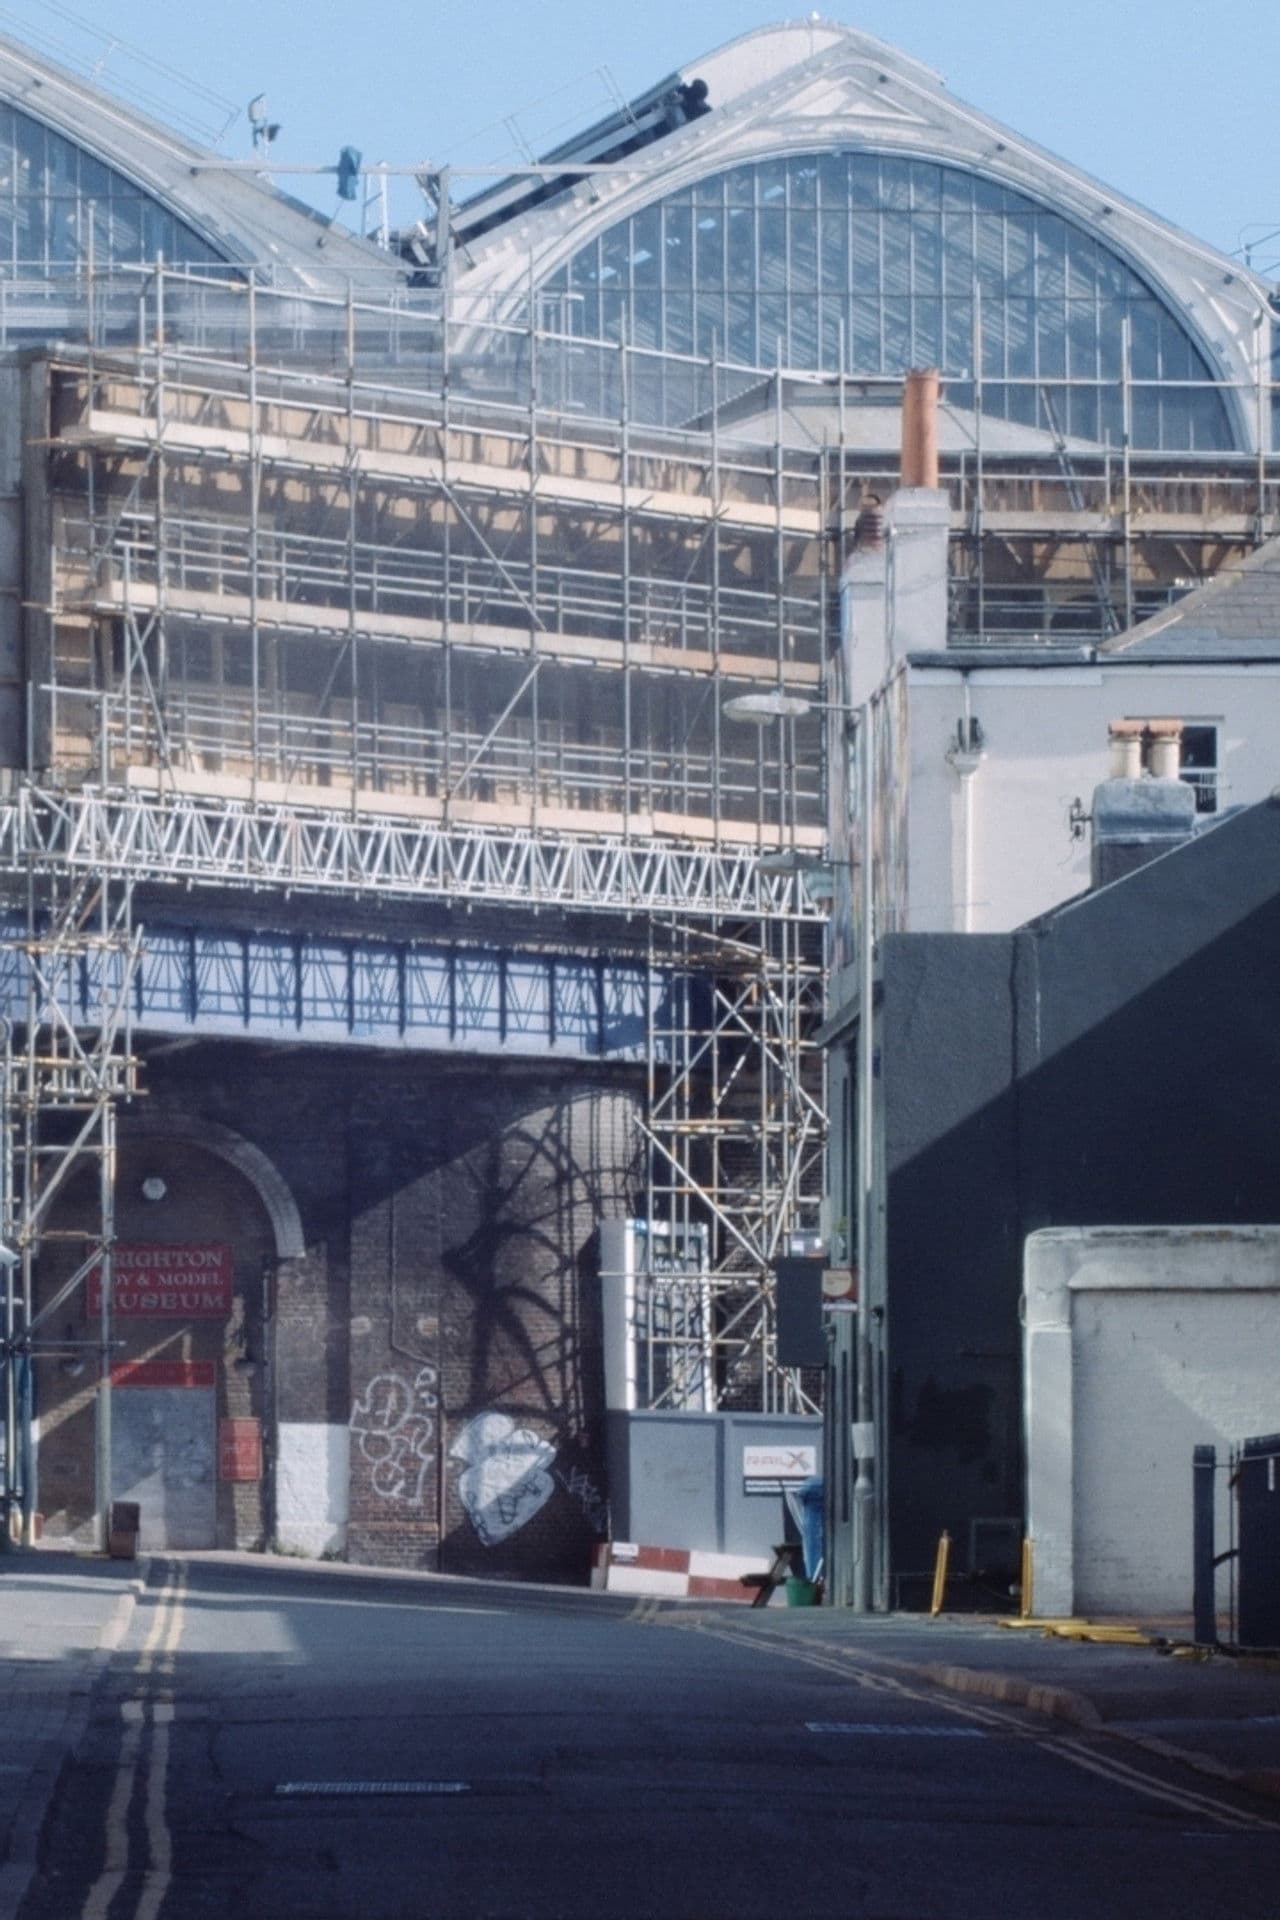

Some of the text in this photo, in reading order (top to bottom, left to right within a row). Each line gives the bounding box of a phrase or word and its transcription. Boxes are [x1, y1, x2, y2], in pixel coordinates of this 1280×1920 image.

[102, 1251, 223, 1268] RIGHTON
[136, 1272, 150, 1286] &
[158, 1272, 225, 1287] MODEL
